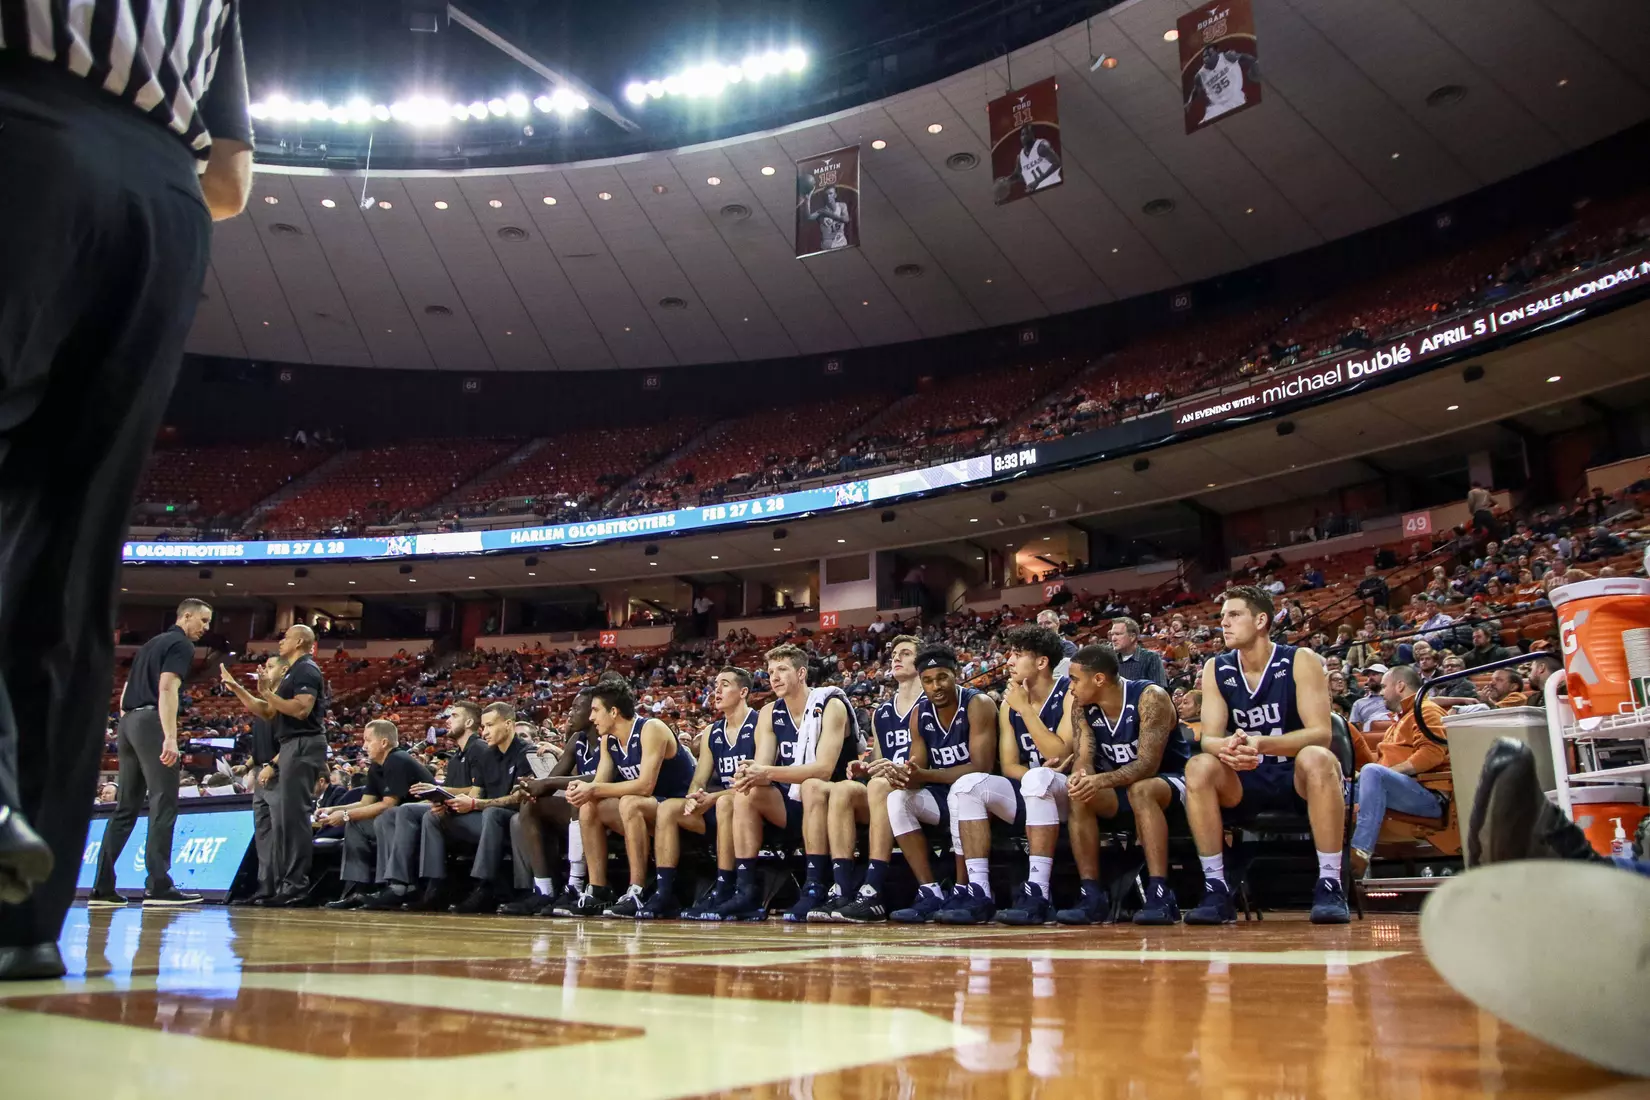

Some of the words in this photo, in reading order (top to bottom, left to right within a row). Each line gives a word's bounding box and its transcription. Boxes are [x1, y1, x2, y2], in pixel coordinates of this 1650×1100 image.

[1197, 8, 1230, 30] DURANT
[1212, 76, 1230, 95] 35
[1012, 100, 1031, 113] FORD
[1013, 108, 1033, 127] 11
[814, 163, 841, 175] MARTIN
[819, 170, 837, 186] 15
[1023, 332, 1034, 341] 61
[1181, 413, 1194, 424] AN
[1194, 402, 1232, 419] EVENING
[1231, 395, 1256, 409] WITH
[1262, 363, 1342, 404] michael
[1347, 342, 1411, 379] bublé
[1419, 325, 1472, 355] APRIL
[1473, 318, 1487, 335] 5
[1498, 307, 1525, 325] ON
[1525, 293, 1563, 317] SALE
[1562, 265, 1639, 303] MONDAY,
[827, 362, 838, 371] 62
[994, 453, 1018, 471] 8:33
[1019, 448, 1036, 466] PM
[702, 506, 726, 521] FEB
[729, 503, 748, 518] 27
[751, 501, 762, 515] &
[766, 497, 784, 512] 28
[510, 527, 564, 544] HARLEM
[568, 514, 676, 538] GLOBETROTTERS
[1407, 516, 1427, 531] 49
[136, 544, 244, 557] GLOBETROTTERS
[267, 543, 290, 555] FEB
[293, 542, 311, 555] 27
[313, 542, 324, 554] &
[327, 541, 344, 554] 28
[1046, 584, 1061, 598] 20
[823, 614, 836, 626] 21
[602, 633, 615, 645] 22
[1560, 620, 1578, 655] G
[1274, 669, 1287, 679] WAC
[1232, 703, 1281, 728] CBU
[930, 741, 970, 765] CBU
[1101, 739, 1139, 763] CBU
[718, 754, 747, 773] CBU
[175, 837, 228, 864] AT&T
